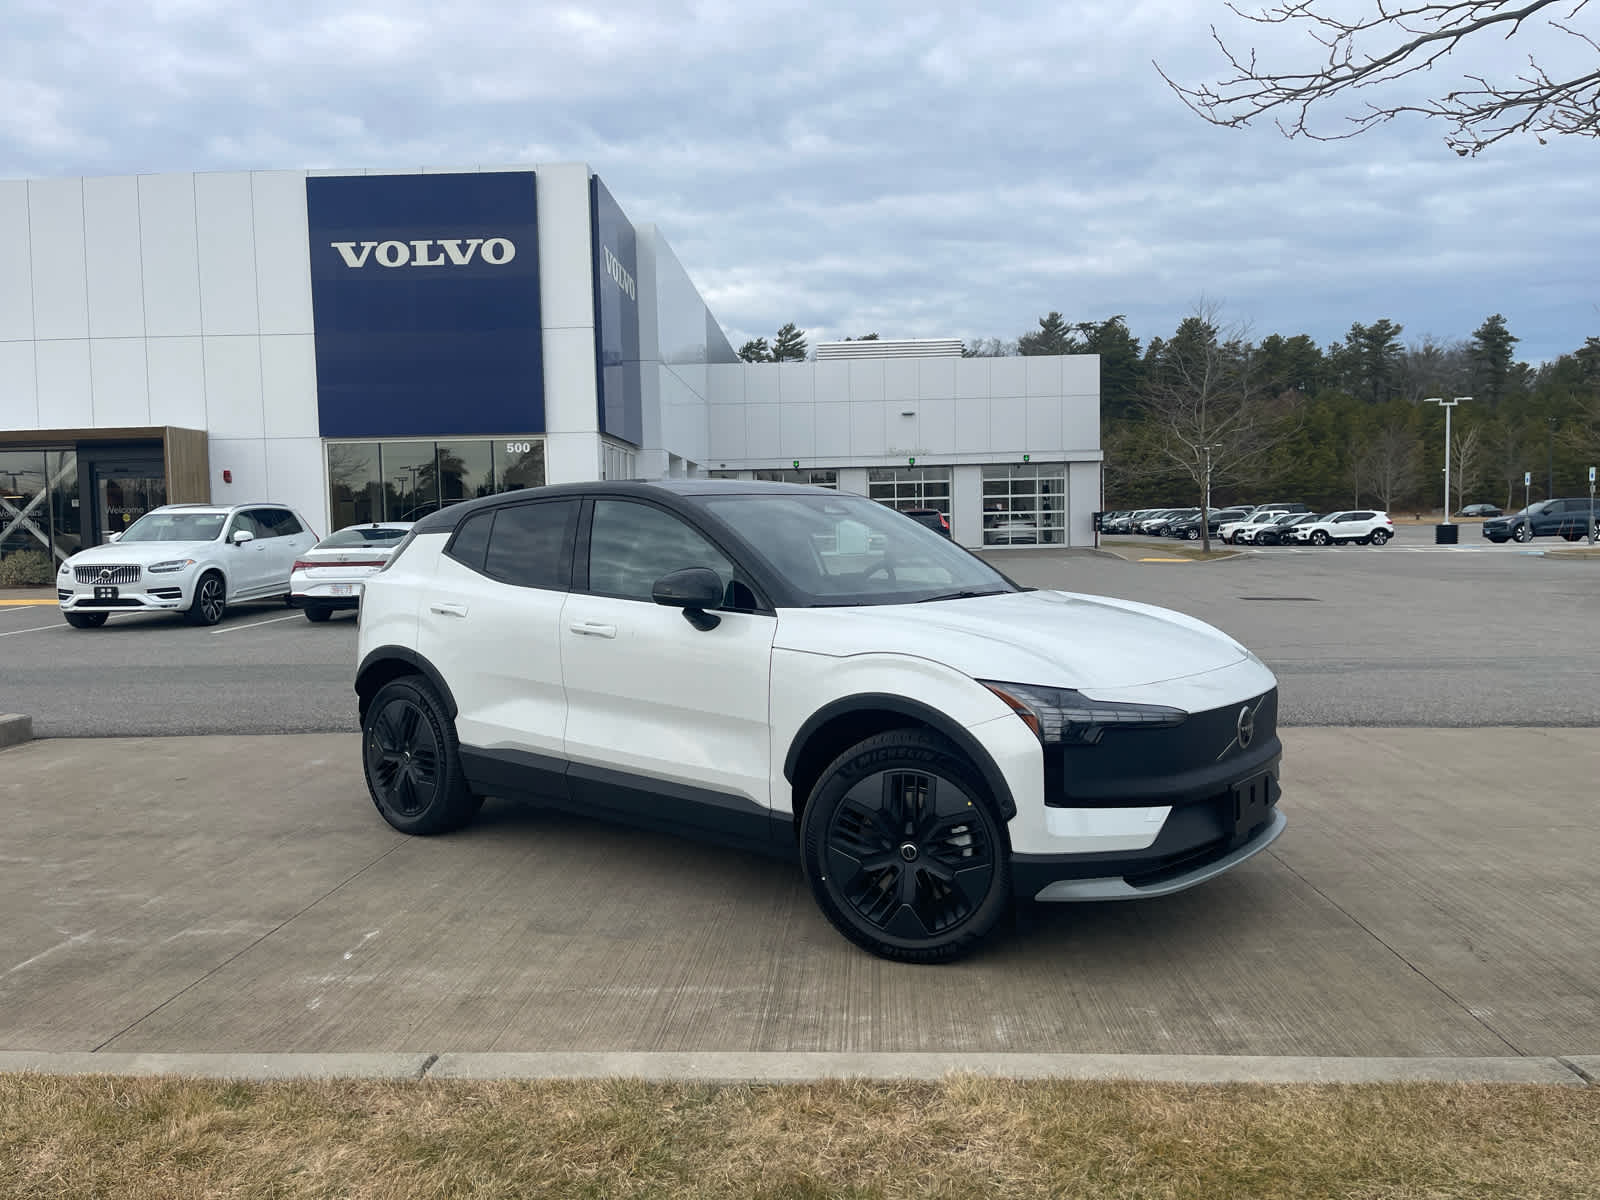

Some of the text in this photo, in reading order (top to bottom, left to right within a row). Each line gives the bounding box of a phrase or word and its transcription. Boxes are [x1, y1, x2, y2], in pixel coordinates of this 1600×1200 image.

[331, 238, 516, 268] VOLVO
[603, 246, 636, 301] VOLVO
[506, 442, 531, 453] 500
